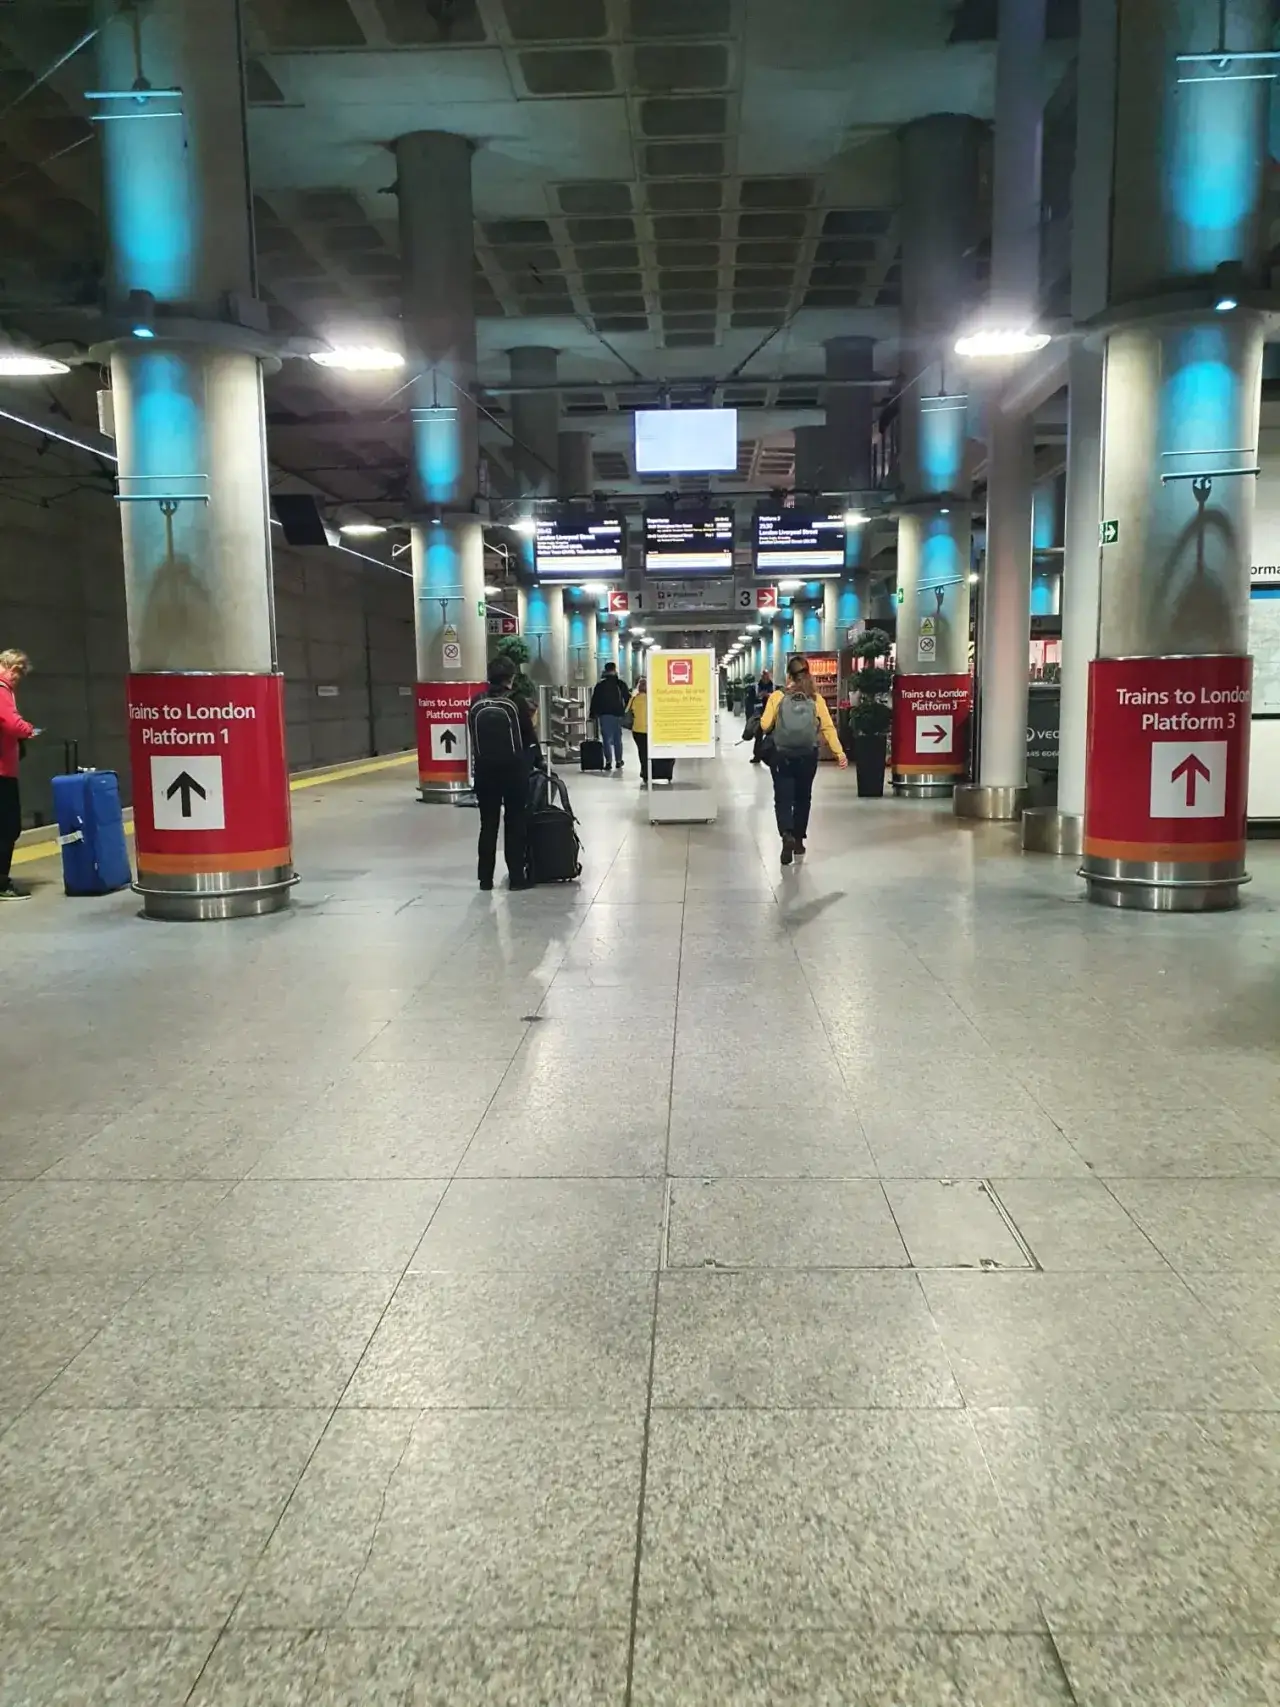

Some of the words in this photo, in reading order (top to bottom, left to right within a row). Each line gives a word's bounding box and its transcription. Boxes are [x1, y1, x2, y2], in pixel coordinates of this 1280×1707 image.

[634, 593, 643, 608] 1
[740, 591, 751, 607] 3
[901, 690, 924, 698] Trains
[1116, 688, 1169, 704] Trains
[1174, 689, 1196, 704] to
[1200, 686, 1251, 704] London
[129, 703, 158, 719] Trains
[162, 705, 182, 719] to
[186, 702, 256, 719] London
[911, 702, 950, 711] Platform
[952, 702, 958, 710] 3
[426, 711, 463, 719] Platform
[1142, 713, 1223, 730] Platform
[1227, 712, 1236, 729] 3
[142, 728, 215, 744] Platform
[220, 728, 229, 744] 1
